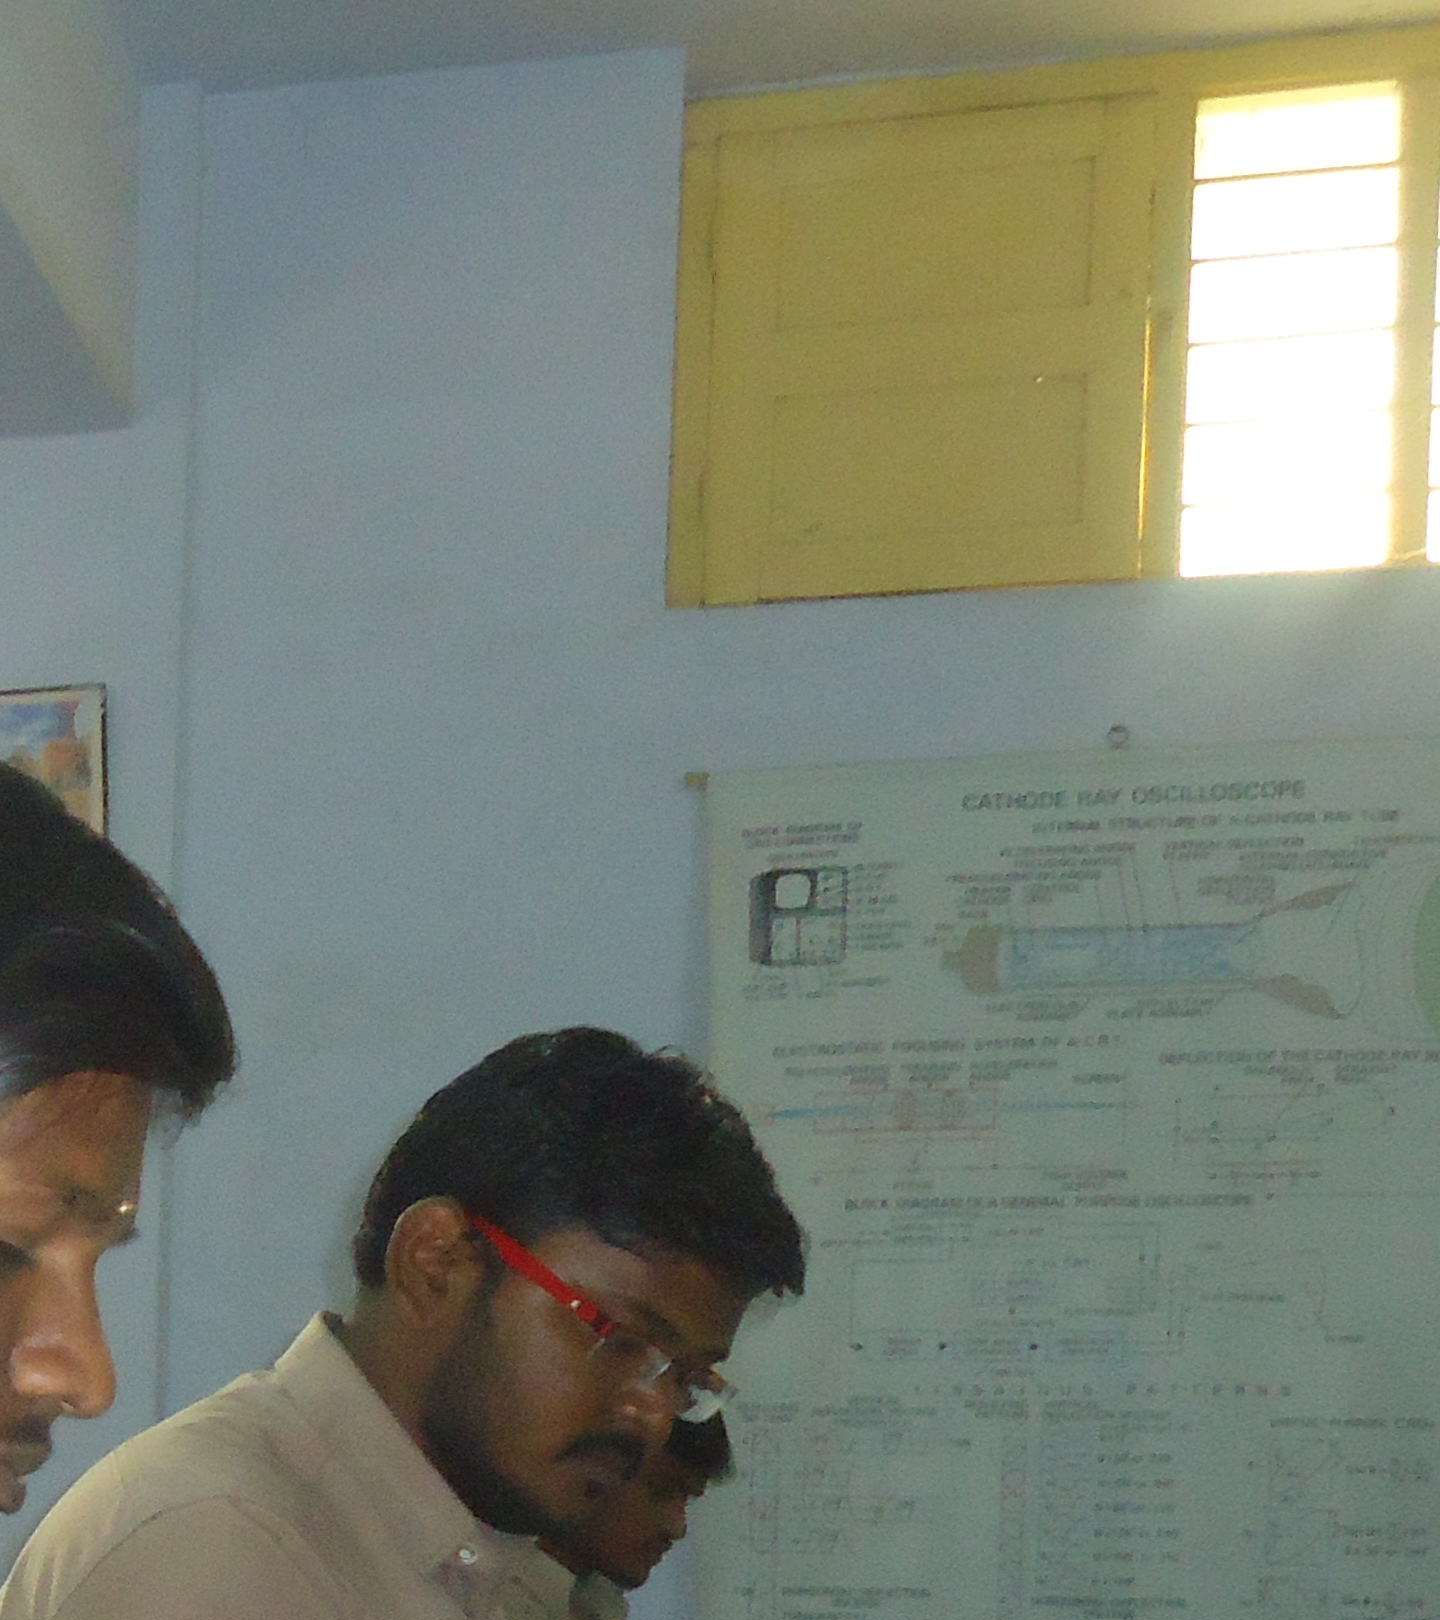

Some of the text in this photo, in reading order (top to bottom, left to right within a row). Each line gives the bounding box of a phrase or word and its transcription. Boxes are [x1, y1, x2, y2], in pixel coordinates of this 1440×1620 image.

[962, 779, 1305, 811] CATHODE RAY OSCILLOSCOPE
